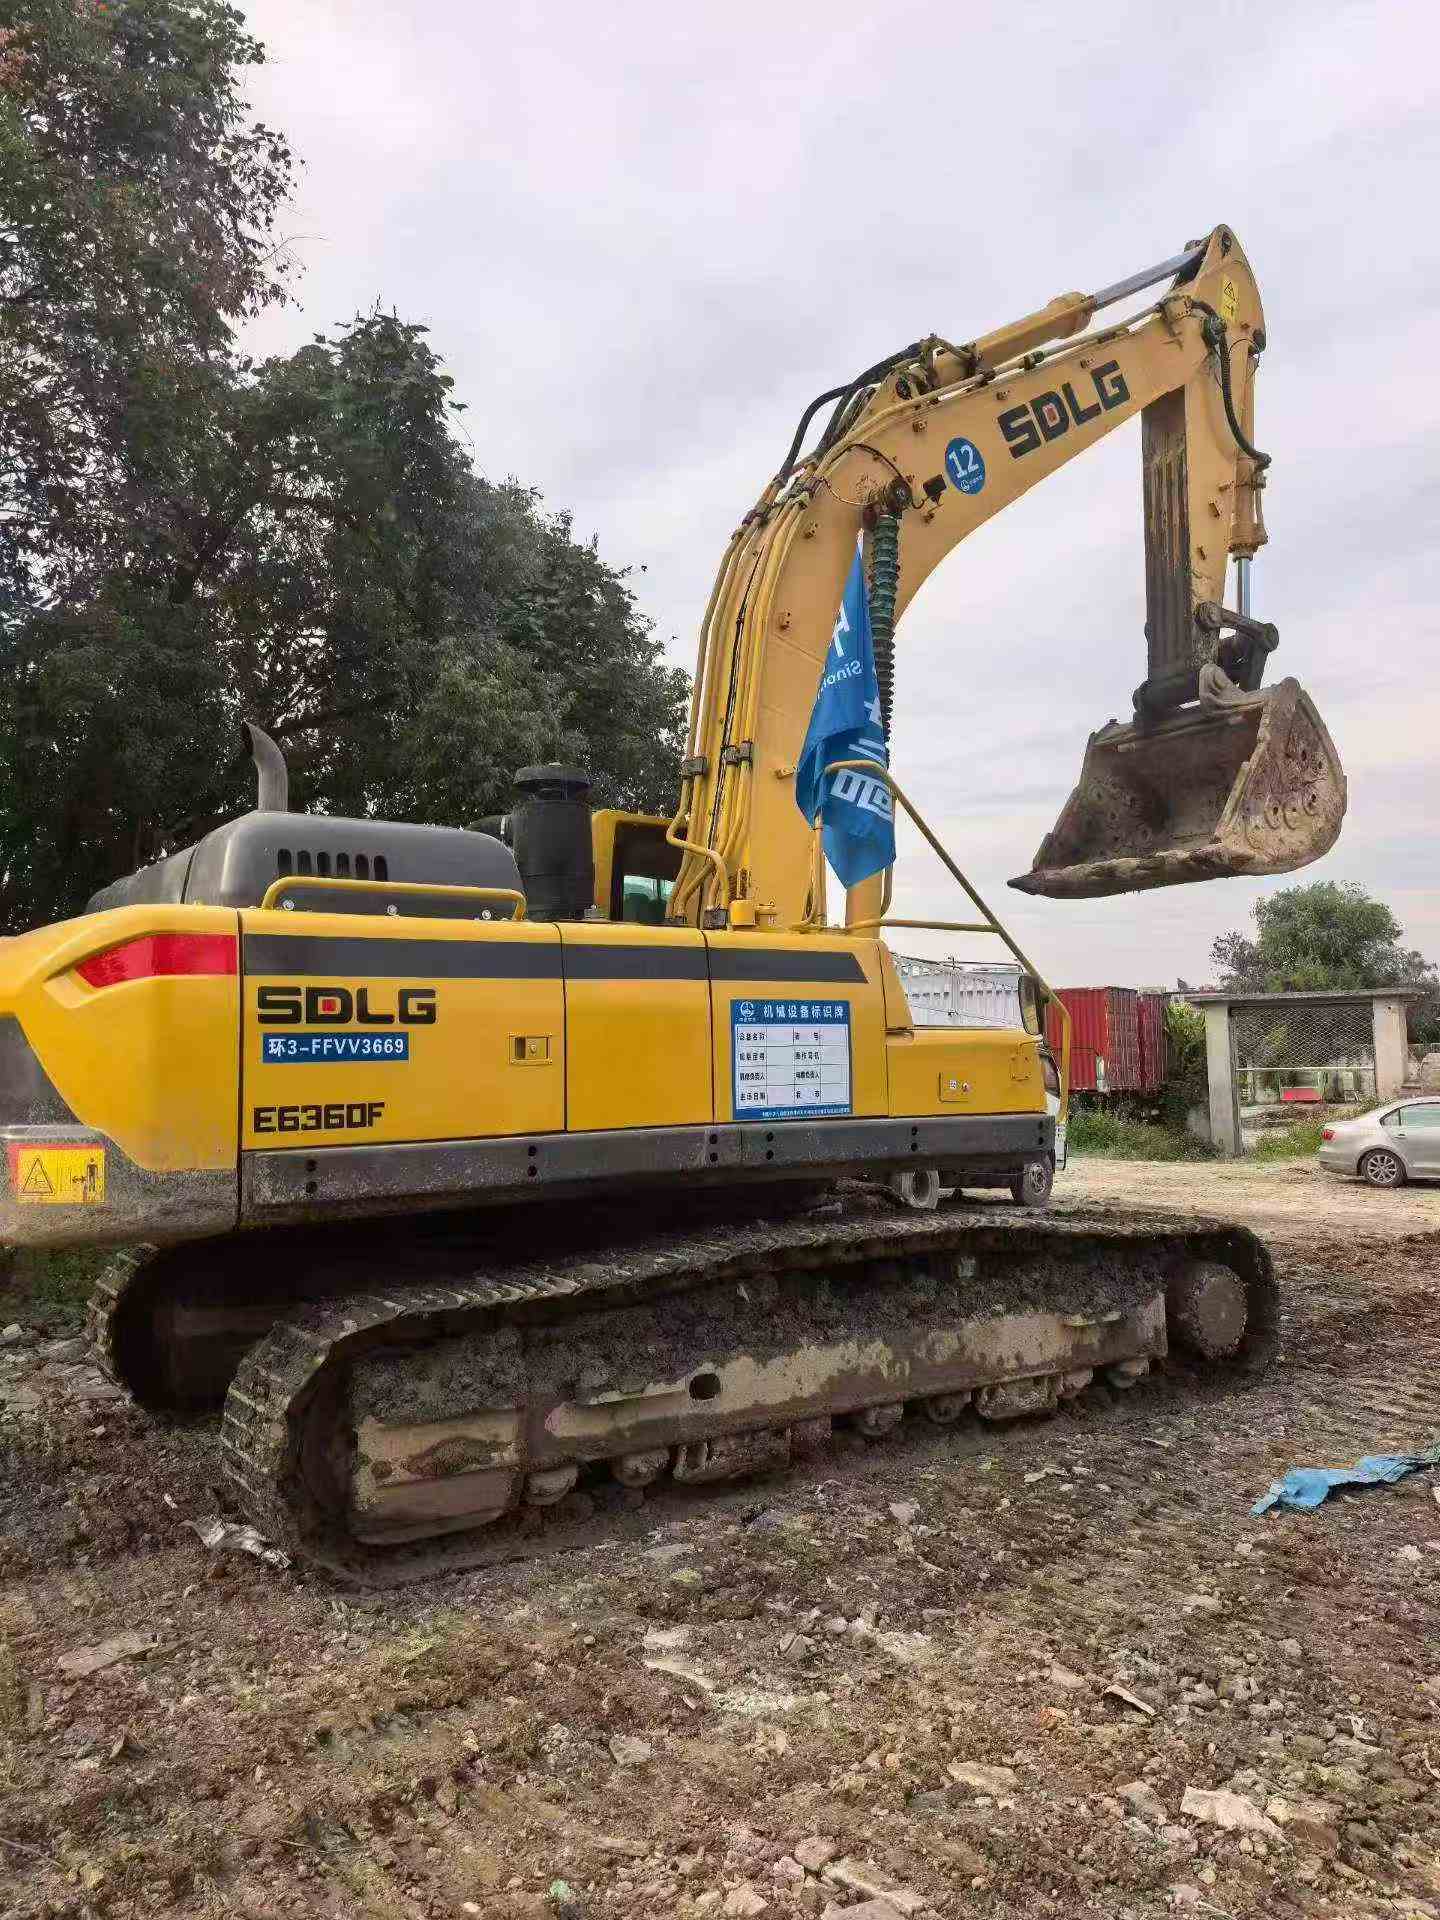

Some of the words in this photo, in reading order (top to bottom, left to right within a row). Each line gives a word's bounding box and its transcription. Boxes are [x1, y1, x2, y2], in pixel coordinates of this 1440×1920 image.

[998, 360, 1130, 459] SDLG
[948, 444, 979, 478] 12
[257, 986, 437, 1024] SDLG
[763, 1005, 844, 1018] 机械设备标识牌
[268, 1038, 404, 1057] 环3-FFVV3669
[253, 1101, 385, 1133] E6360F
